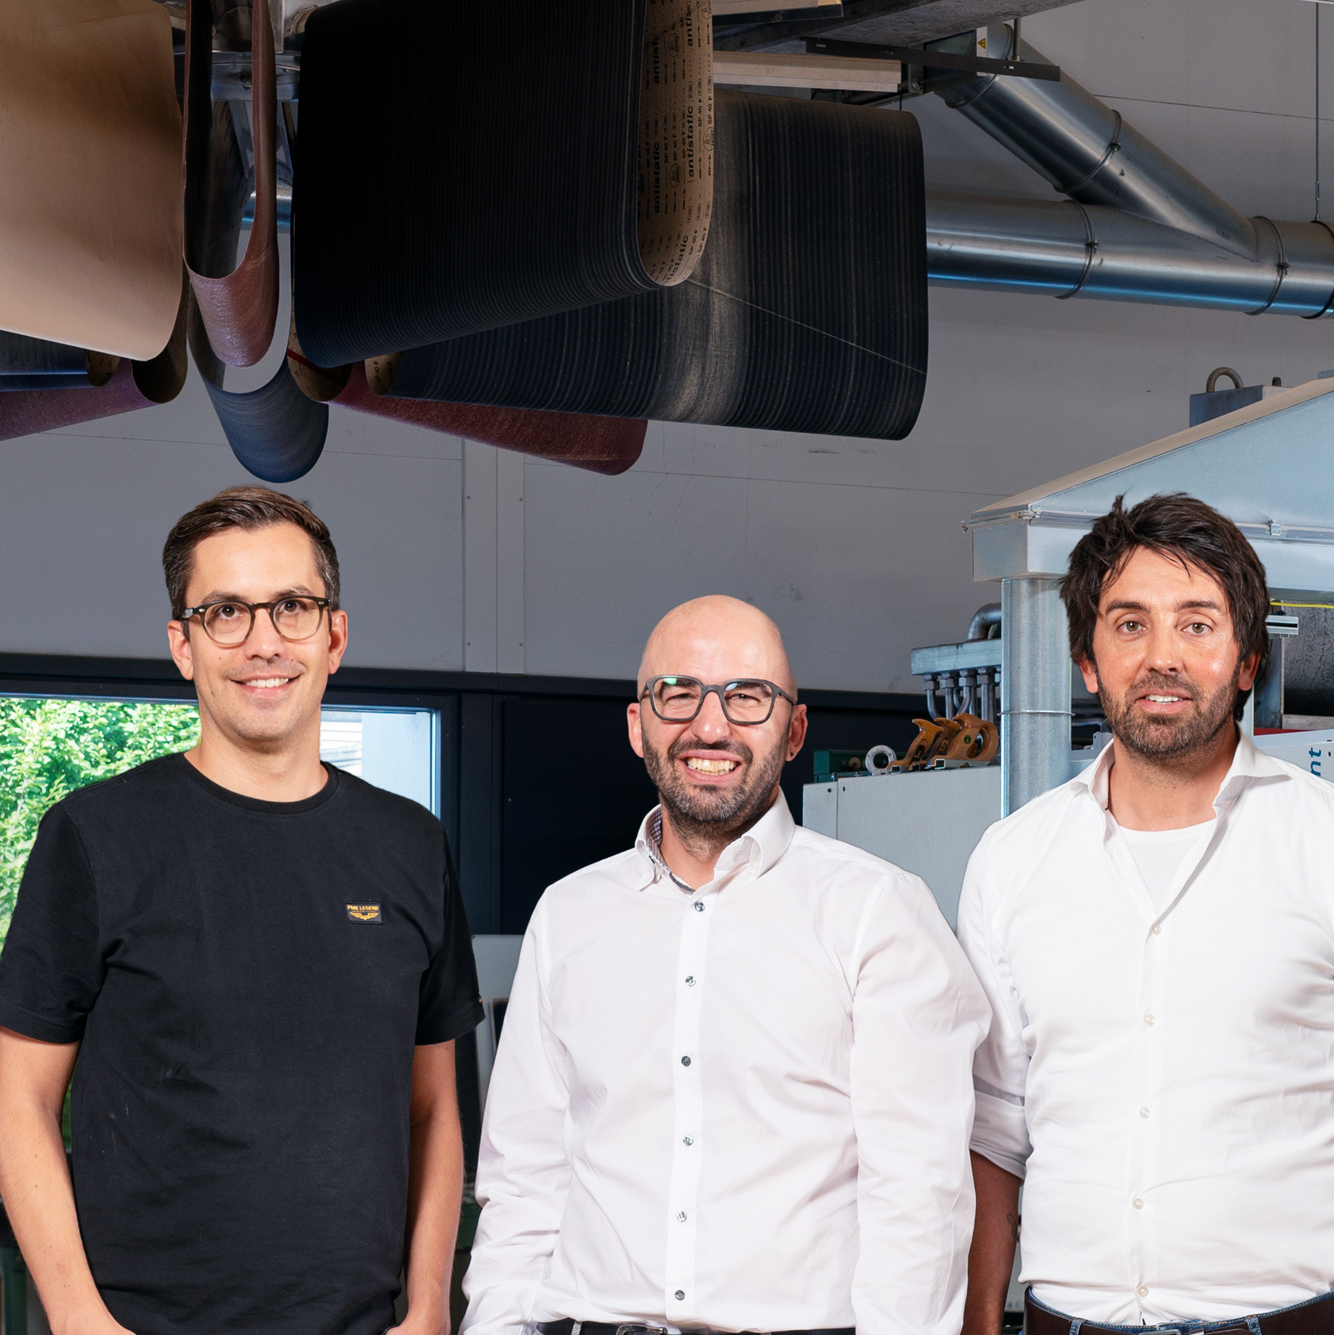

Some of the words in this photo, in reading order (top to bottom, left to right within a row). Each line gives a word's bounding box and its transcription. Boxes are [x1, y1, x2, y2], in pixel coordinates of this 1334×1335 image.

[686, 106, 694, 178] antistatic
[652, 142, 660, 214] antistatic
[665, 235, 689, 283] tistatic
[1308, 747, 1322, 777] nt
